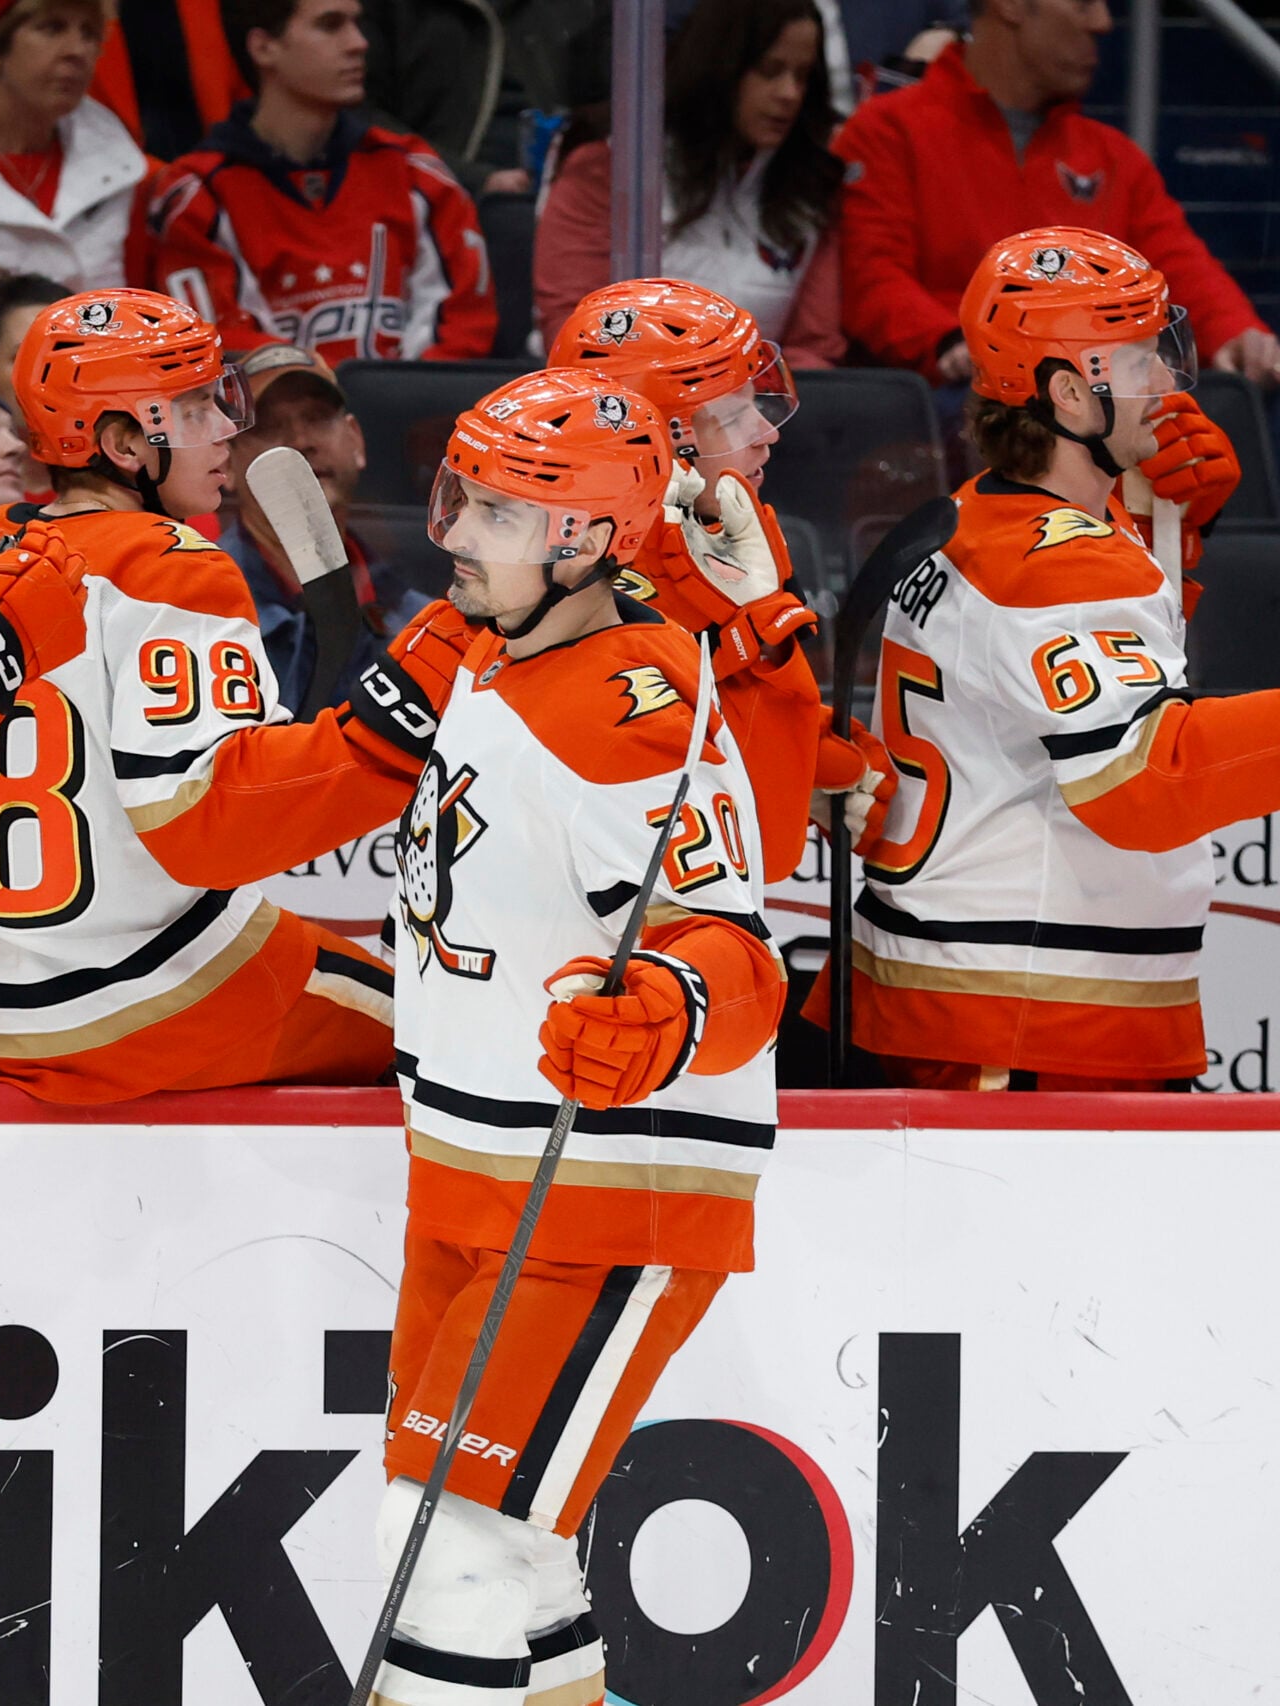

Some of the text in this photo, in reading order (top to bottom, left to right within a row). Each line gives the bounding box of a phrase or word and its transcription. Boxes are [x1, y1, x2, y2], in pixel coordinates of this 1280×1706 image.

[138, 638, 266, 727] 98
[1031, 630, 1167, 714] 65
[646, 792, 749, 895] 20
[379, 1607, 394, 1633] TWITCH
[390, 1582, 402, 1606] TAPER
